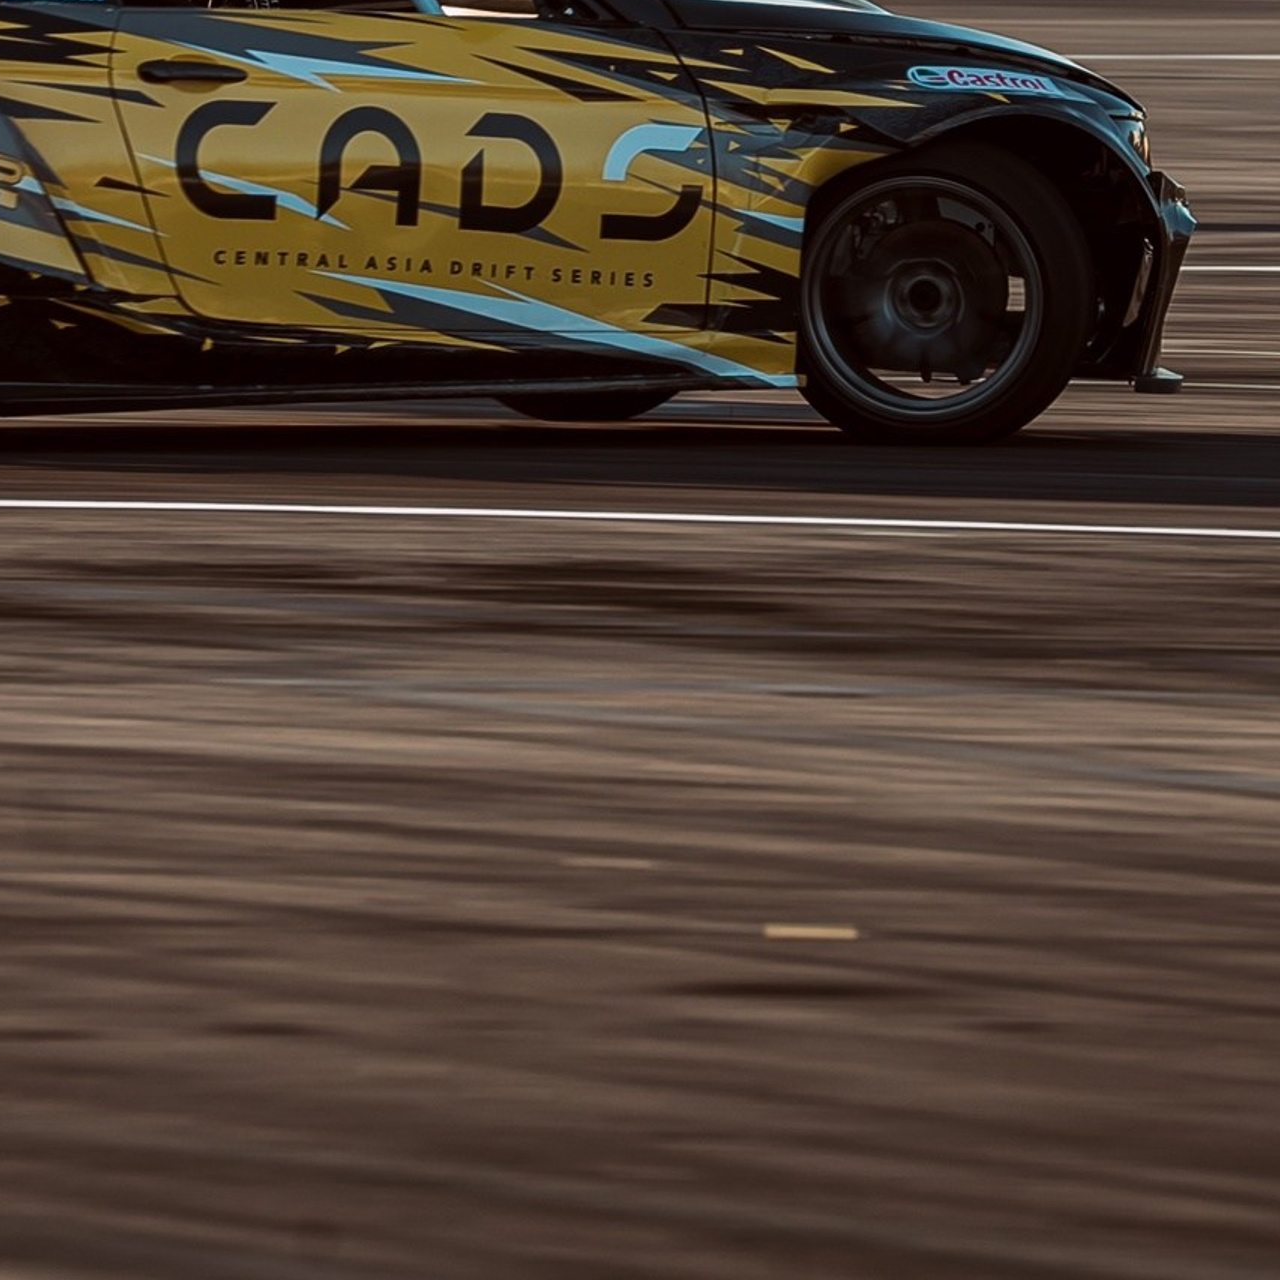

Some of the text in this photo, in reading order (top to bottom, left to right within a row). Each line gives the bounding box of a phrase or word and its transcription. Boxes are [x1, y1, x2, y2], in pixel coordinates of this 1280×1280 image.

[947, 69, 1047, 91] Castrol
[175, 99, 704, 242] CADS
[213, 250, 655, 287] CENTRAL ASIA DRIFT SERIES
